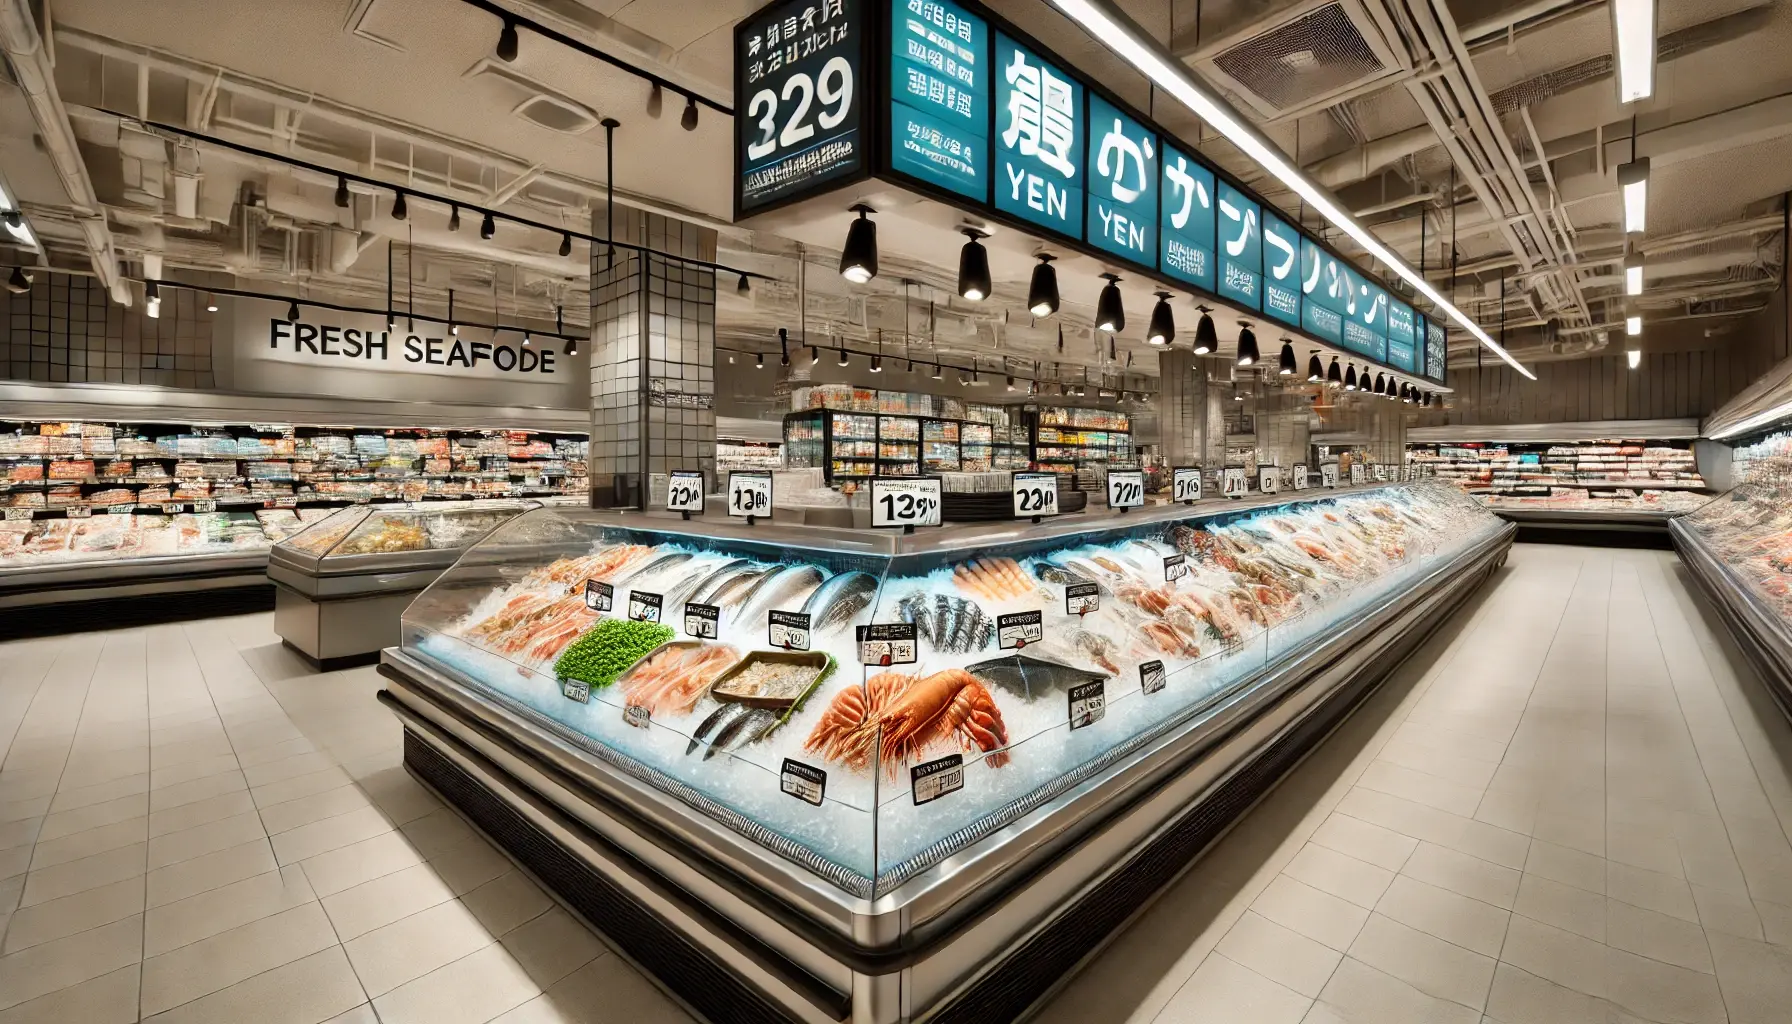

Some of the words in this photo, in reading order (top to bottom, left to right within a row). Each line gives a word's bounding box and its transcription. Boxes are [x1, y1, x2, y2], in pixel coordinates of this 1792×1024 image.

[748, 56, 854, 161] 329
[1006, 162, 1067, 220] YEN
[1098, 204, 1145, 252] YEN
[270, 318, 388, 360] FRESH
[404, 335, 555, 374] SEAFODE
